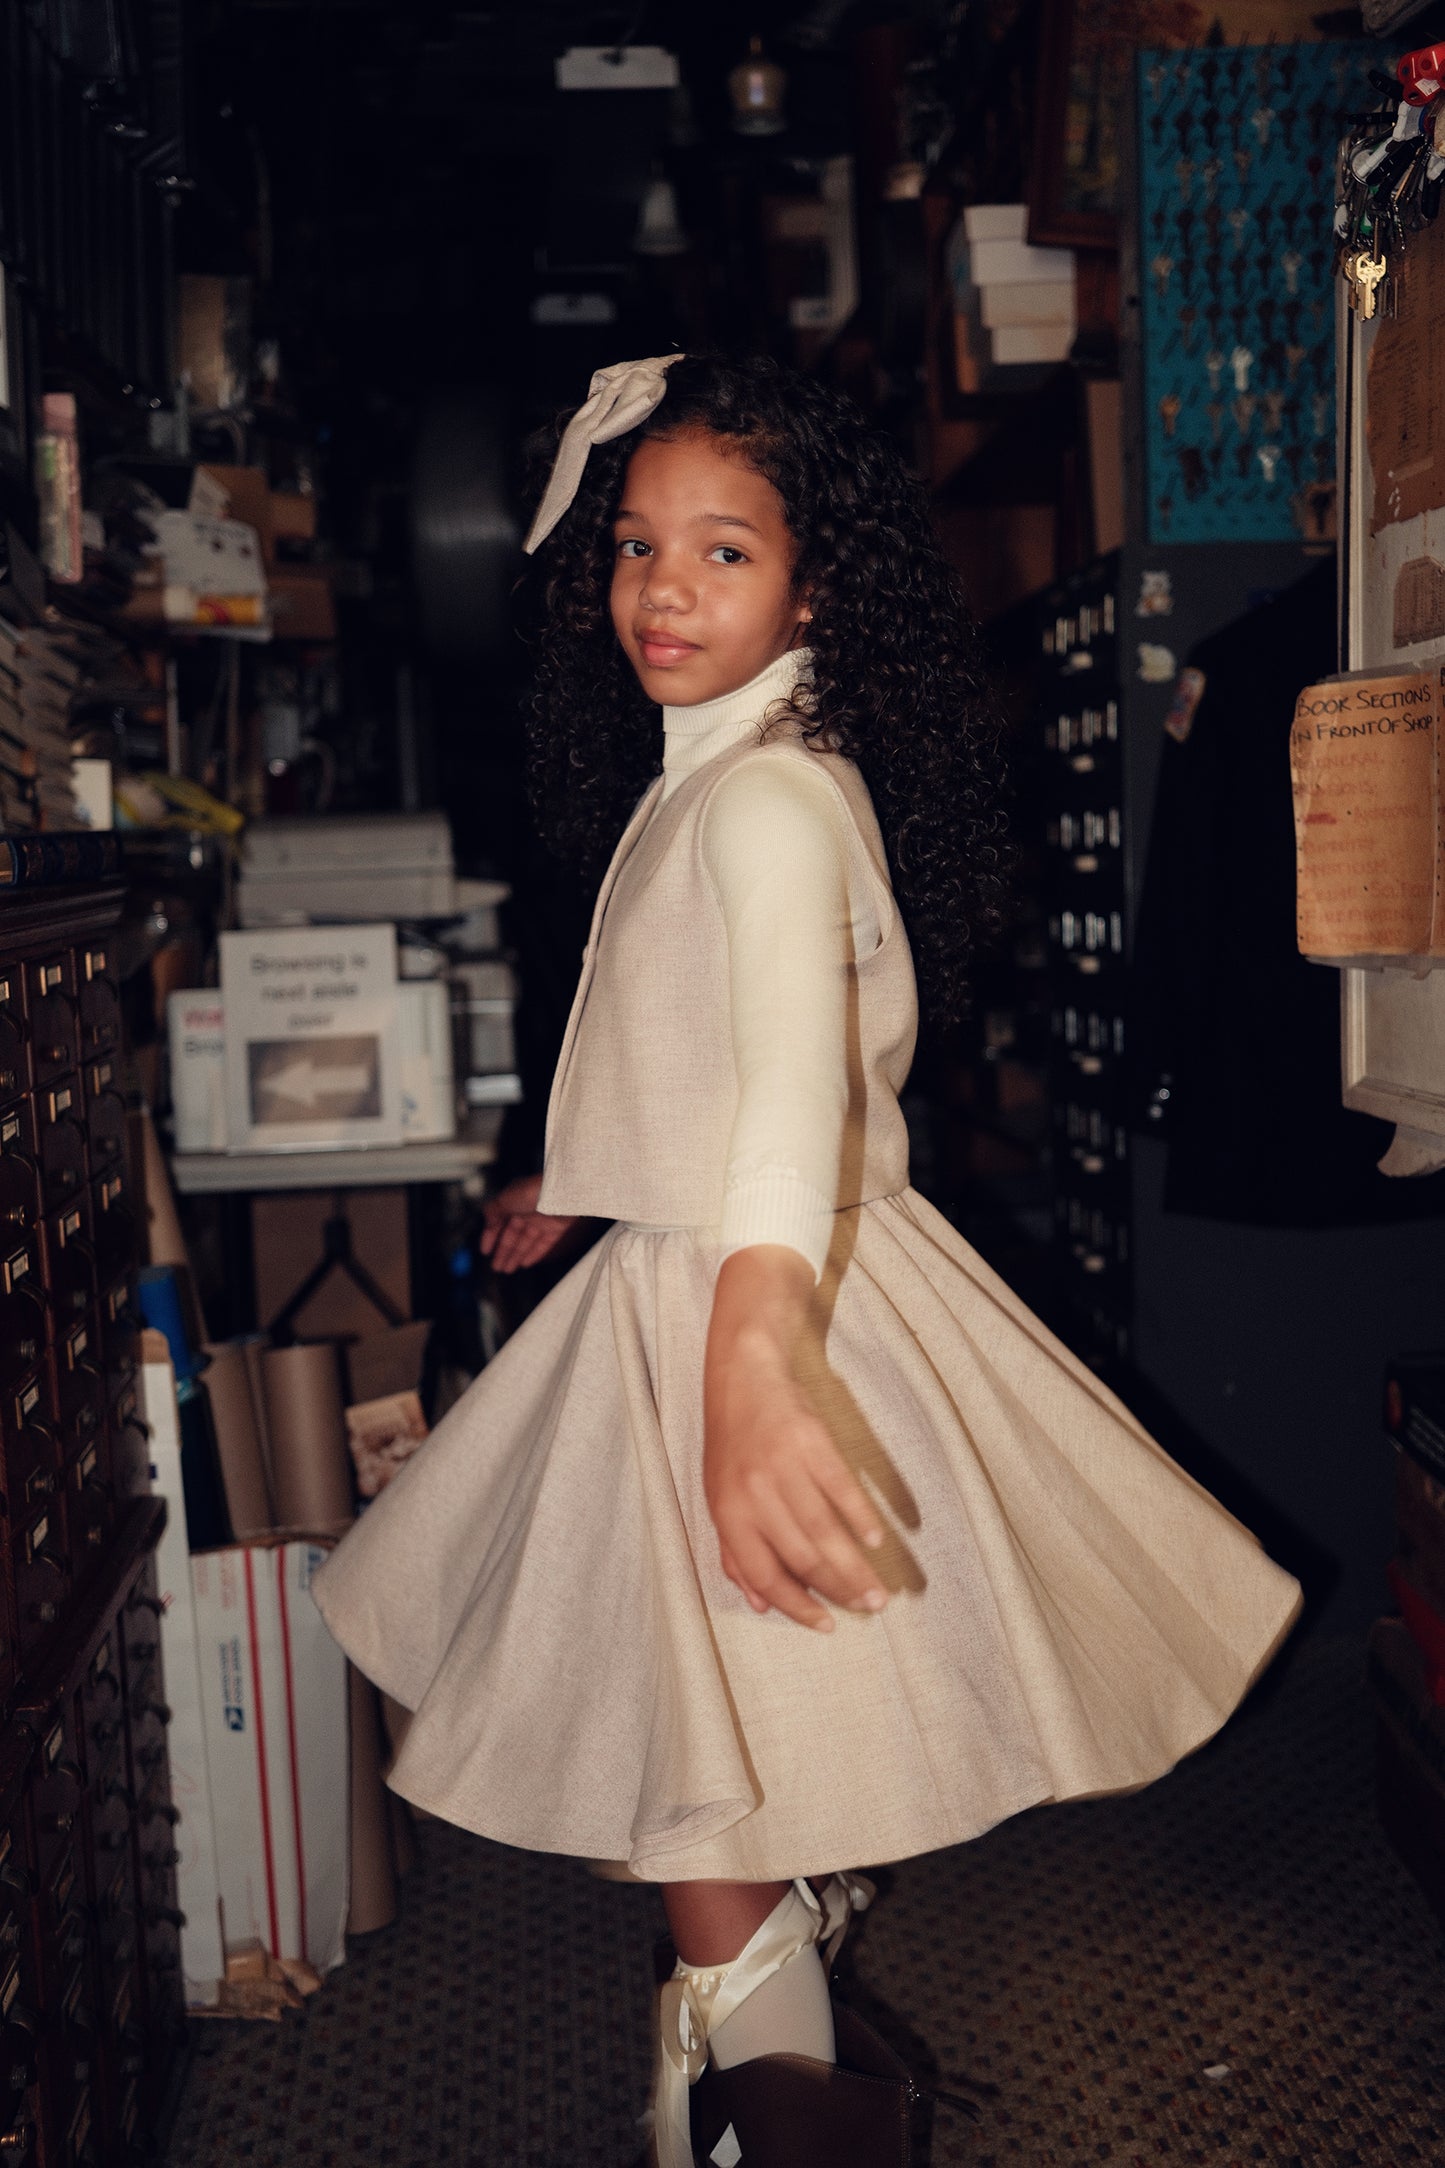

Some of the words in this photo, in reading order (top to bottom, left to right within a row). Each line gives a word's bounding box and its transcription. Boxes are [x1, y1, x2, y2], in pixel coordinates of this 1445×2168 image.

[1298, 697, 1352, 718] BOOK
[1357, 685, 1431, 710] SECTIONS
[1402, 713, 1433, 734] SHOP
